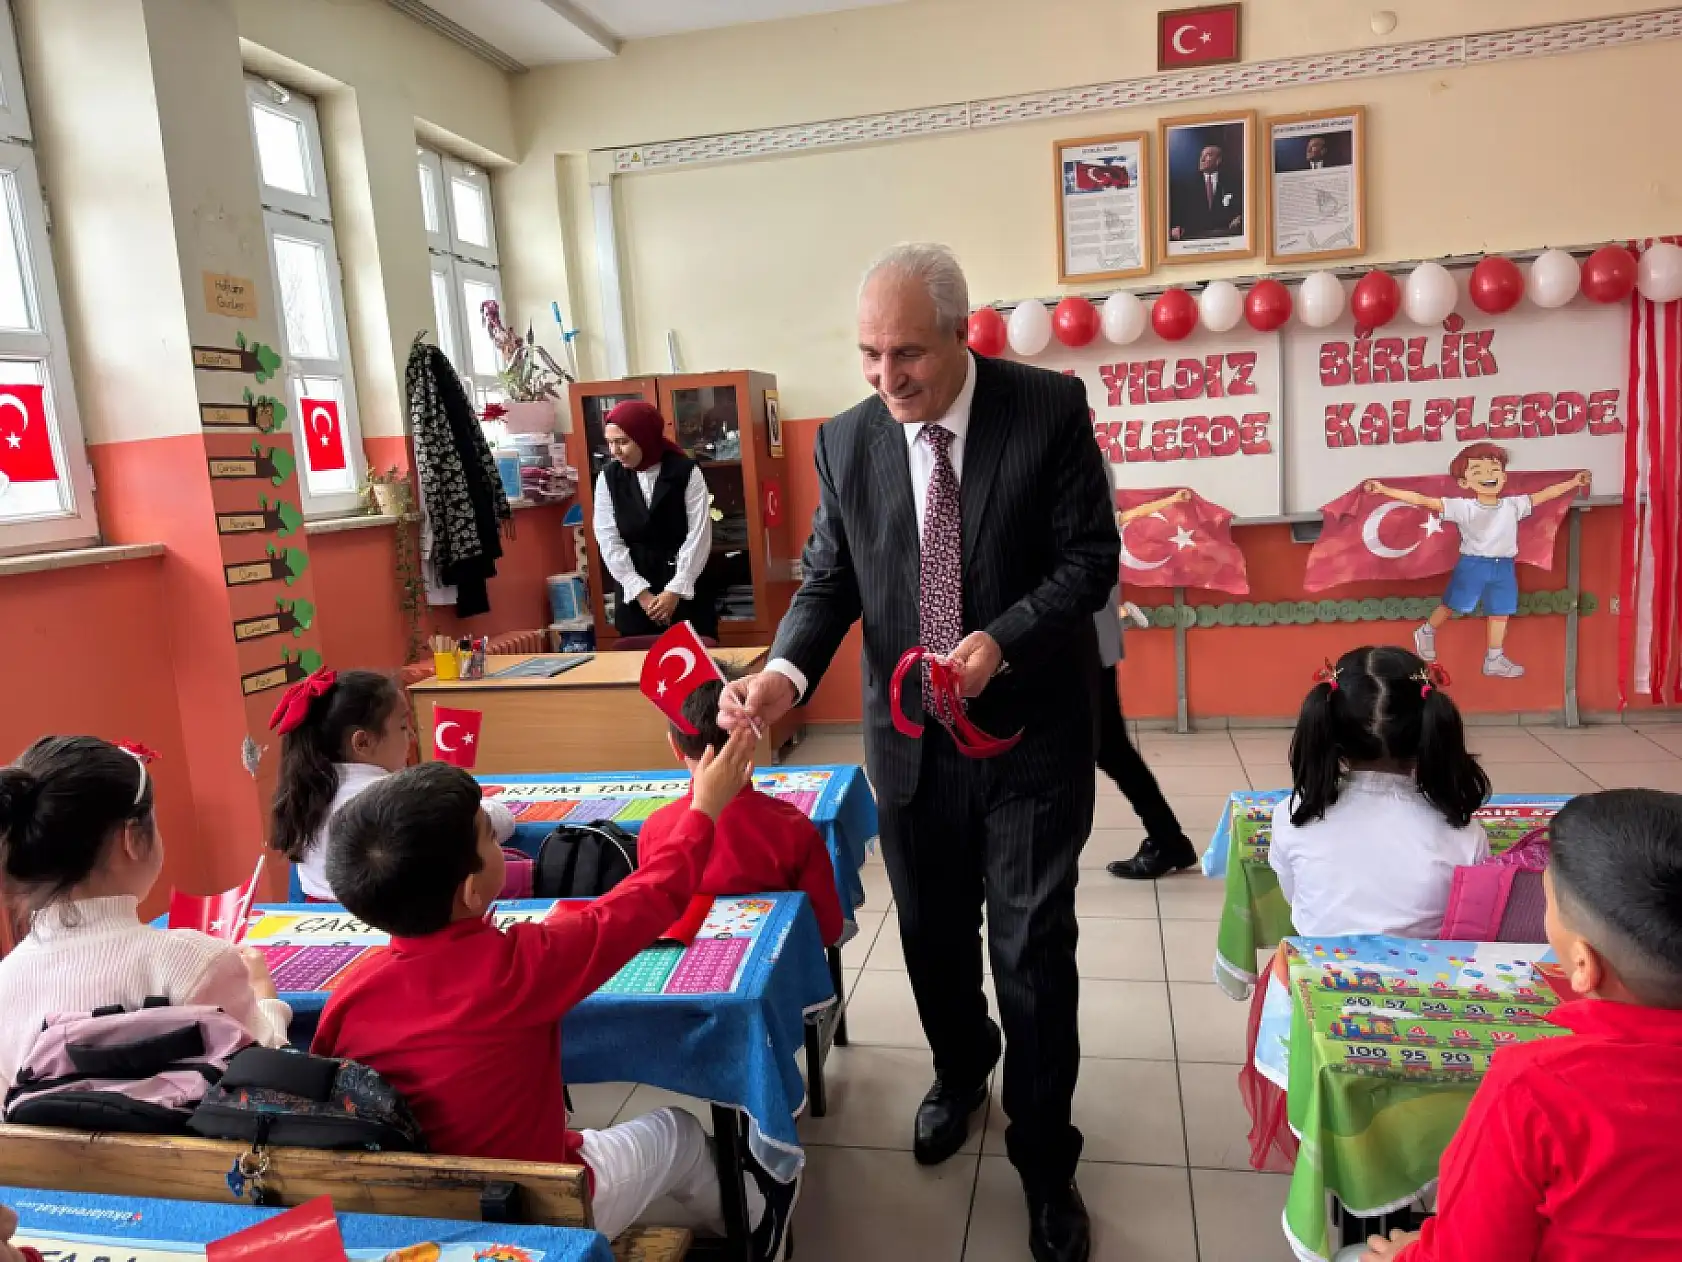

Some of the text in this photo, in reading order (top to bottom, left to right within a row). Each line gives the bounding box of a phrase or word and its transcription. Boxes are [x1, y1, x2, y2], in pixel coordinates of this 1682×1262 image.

[1319, 312, 1499, 386] BİRLİK
[1099, 352, 1257, 407] YILDIZ
[1089, 408, 1272, 463] KLERDE
[1325, 389, 1625, 448] KALPLERDE
[1347, 1046, 1389, 1058] 100
[1400, 1049, 1427, 1061] 95
[1440, 1051, 1472, 1063] 90
